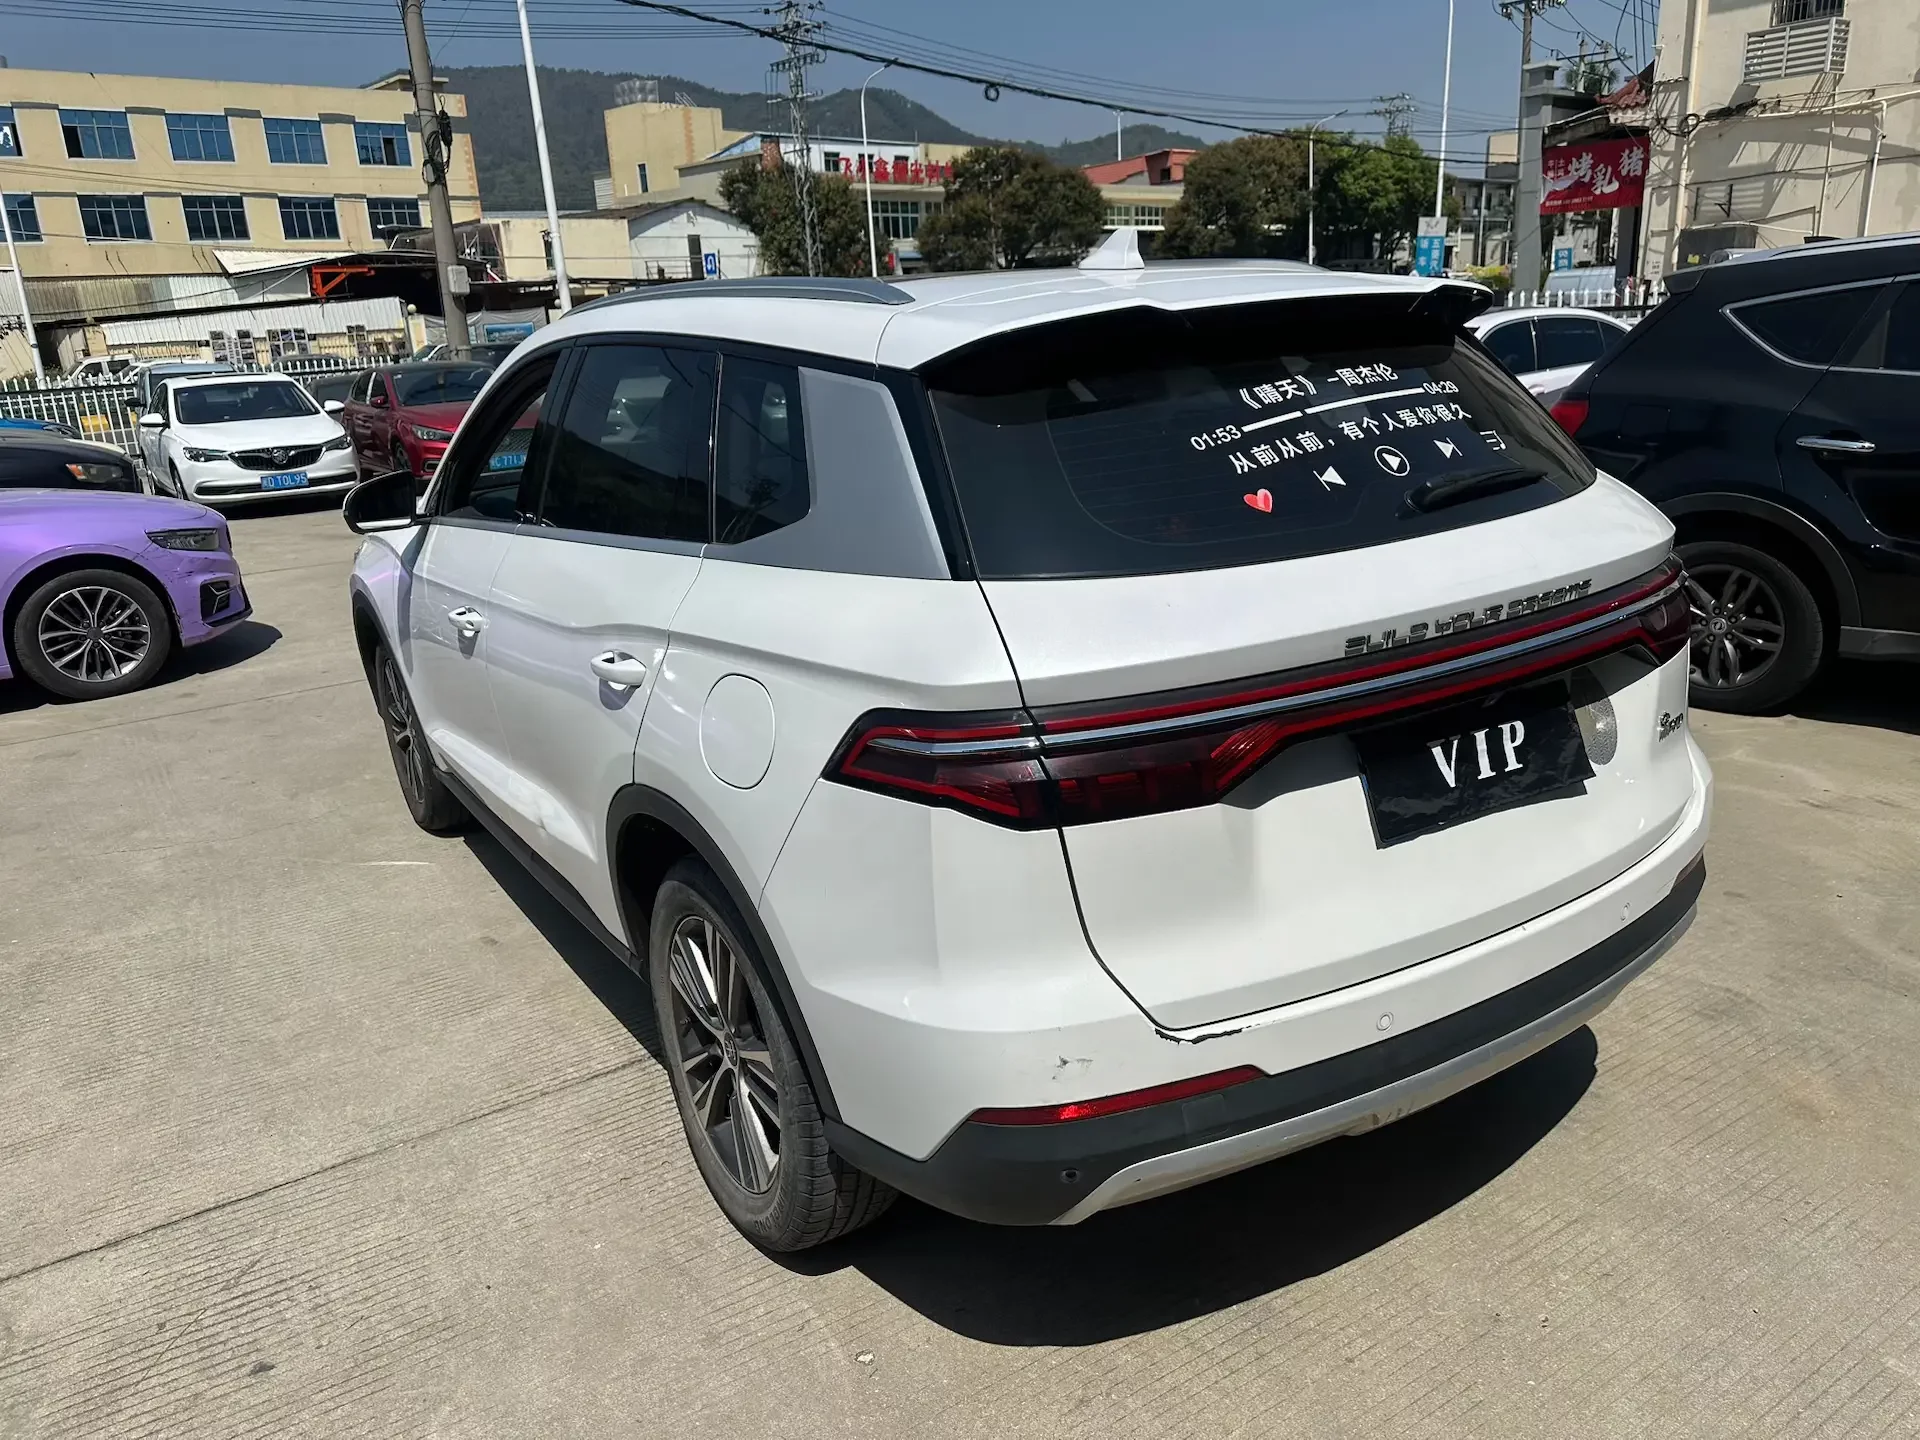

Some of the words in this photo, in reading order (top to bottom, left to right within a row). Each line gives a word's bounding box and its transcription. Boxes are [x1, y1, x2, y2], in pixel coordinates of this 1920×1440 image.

[1567, 146, 1644, 195] 烤乳猪
[1190, 424, 1242, 451] 01:53
[1422, 380, 1460, 395] 04:29
[1239, 375, 1317, 410] 《晴天》
[1426, 720, 1525, 788] VIP
